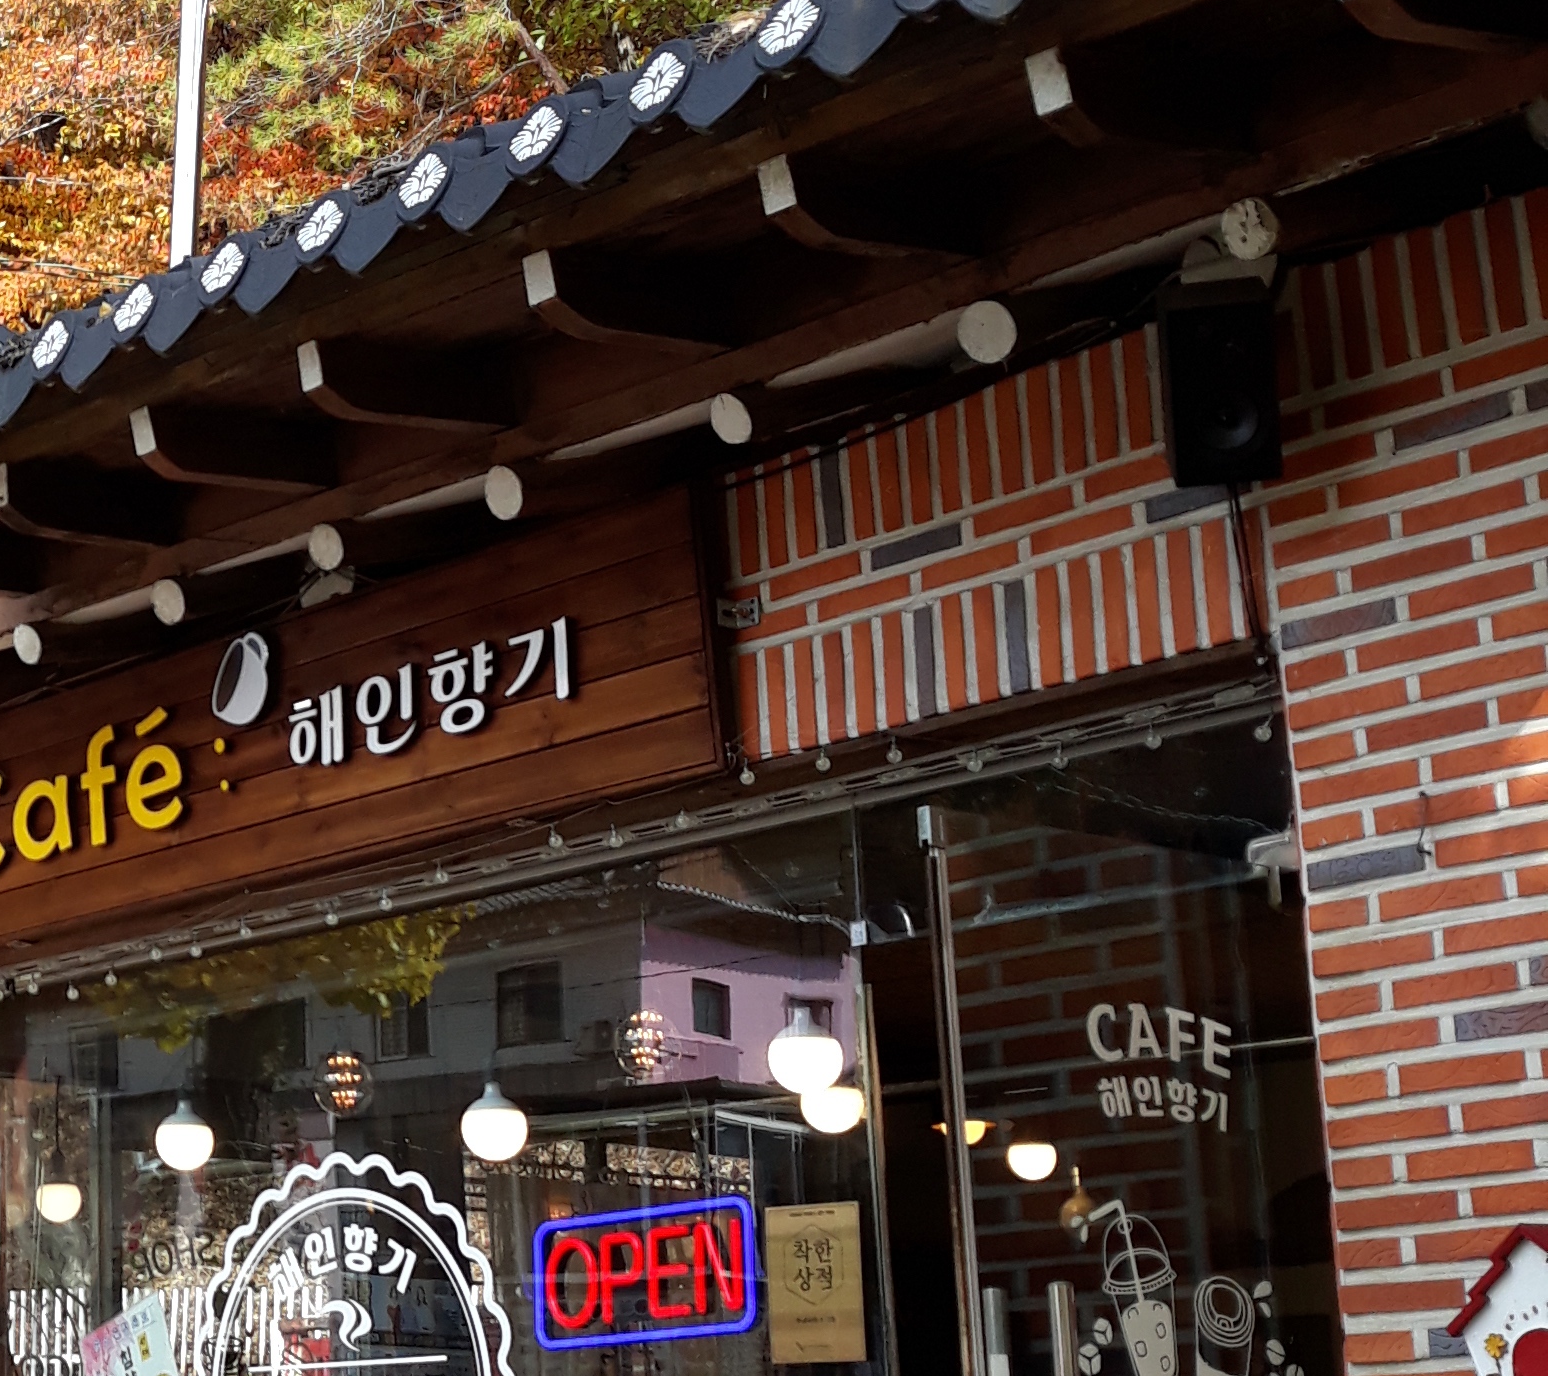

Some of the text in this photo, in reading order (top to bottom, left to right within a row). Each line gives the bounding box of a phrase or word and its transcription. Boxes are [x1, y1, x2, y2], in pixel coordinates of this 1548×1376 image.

[288, 615, 571, 766] 해인향기
[1086, 1002, 1232, 1080] CAFE
[1096, 1075, 1229, 1133] 해인향기
[266, 1223, 418, 1301] 해인향기
[544, 1217, 745, 1330] OPEN
[793, 1237, 834, 1264] 착한
